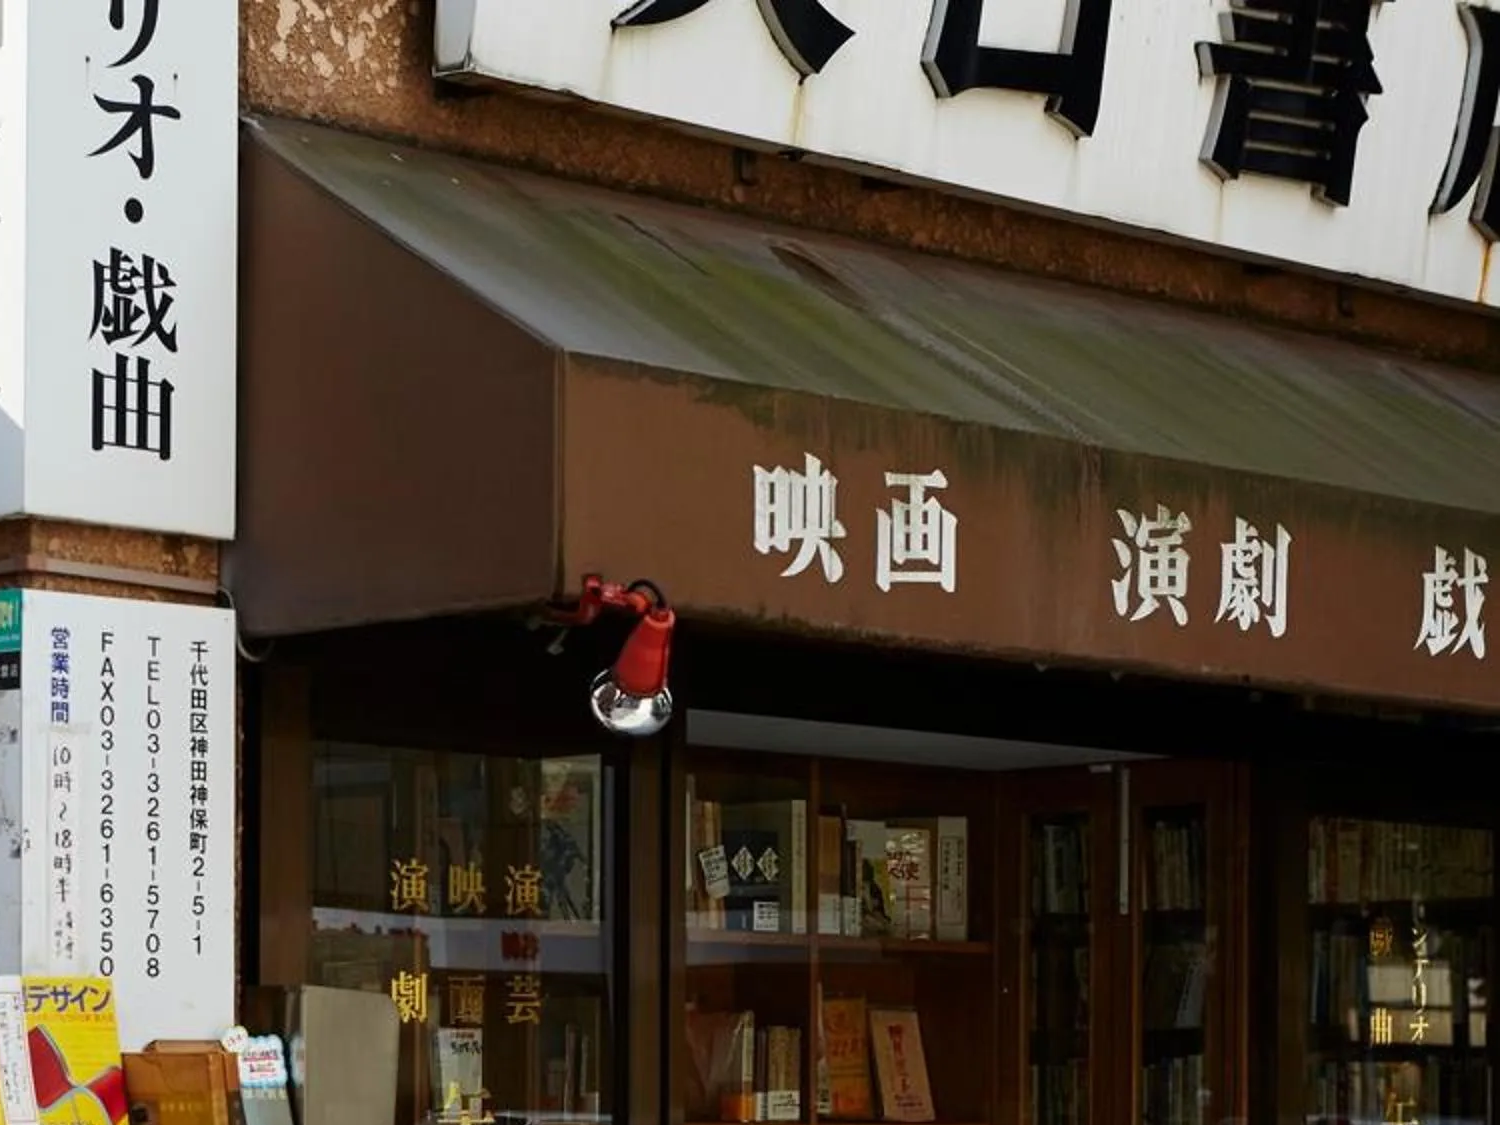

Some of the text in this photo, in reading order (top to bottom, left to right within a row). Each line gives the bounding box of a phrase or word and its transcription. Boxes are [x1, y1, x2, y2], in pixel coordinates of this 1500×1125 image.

[753, 452, 1489, 659] 映画 演劇 戯
[50, 627, 71, 724] 営業時間
[190, 641, 209, 954] 千代田区神田神保町2-5-1
[23, 983, 111, 1013] デザイン
